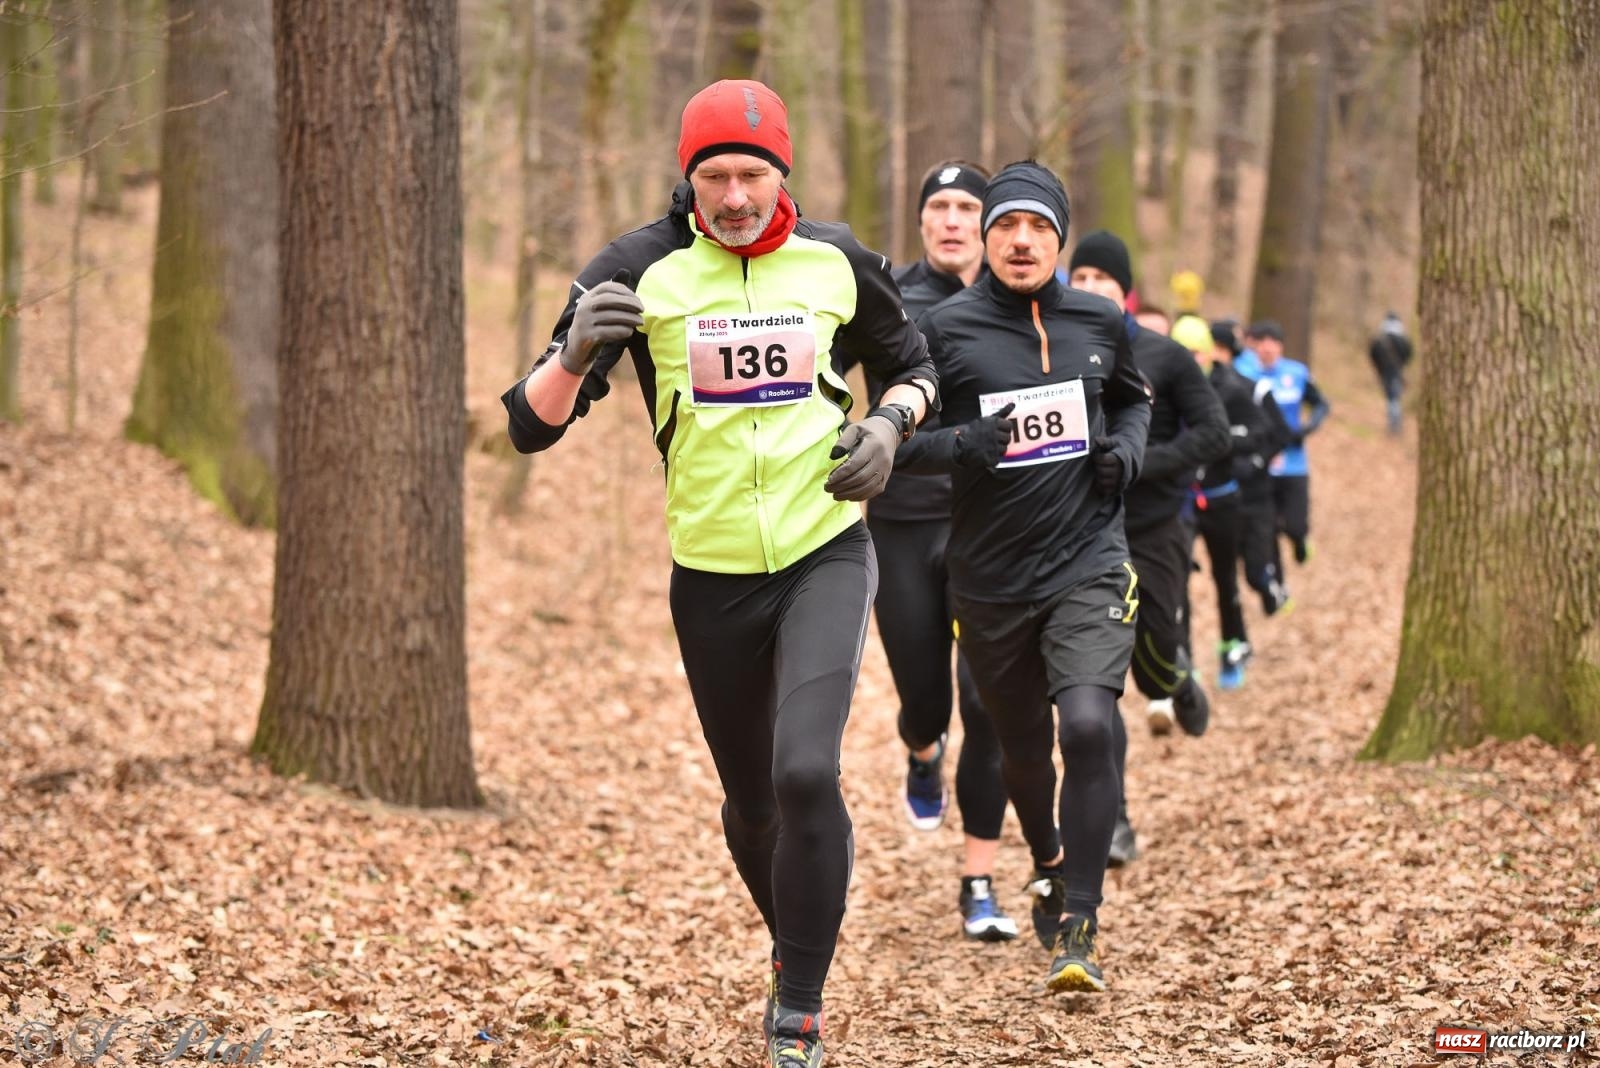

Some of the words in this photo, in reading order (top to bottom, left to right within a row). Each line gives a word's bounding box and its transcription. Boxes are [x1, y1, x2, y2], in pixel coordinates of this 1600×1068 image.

[698, 319, 728, 330] BIEG
[731, 315, 804, 328] Twardziela
[718, 343, 788, 380] 136
[1017, 387, 1074, 401] Twardziela
[1008, 411, 1064, 443] 168
